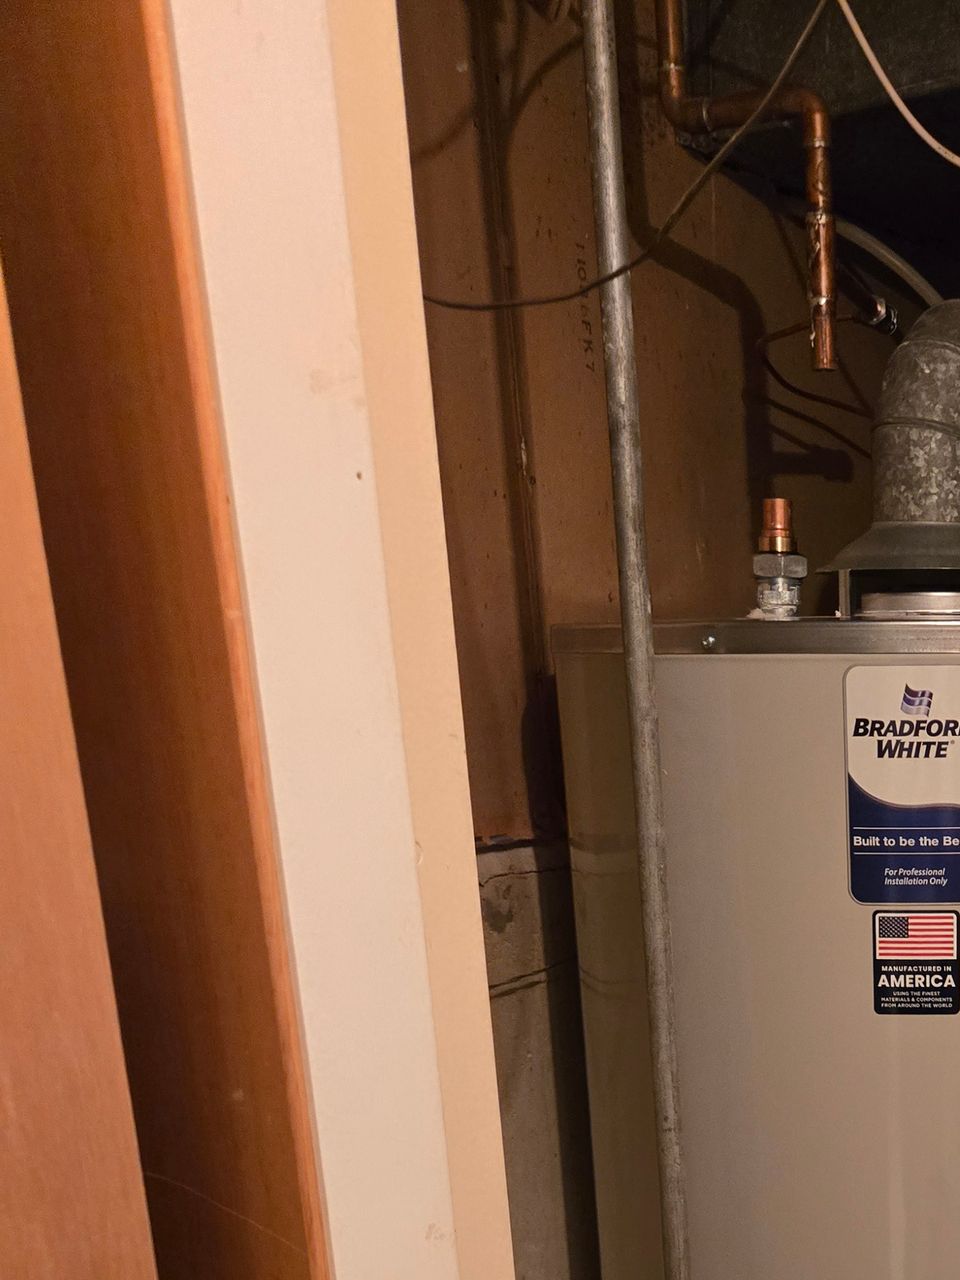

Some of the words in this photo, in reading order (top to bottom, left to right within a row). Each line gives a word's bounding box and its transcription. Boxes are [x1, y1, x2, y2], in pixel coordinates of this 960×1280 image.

[877, 739, 949, 758] WHITE
[853, 836, 880, 846] Built
[883, 836, 896, 846] to
[899, 836, 915, 846] be
[919, 836, 939, 846] the
[884, 868, 897, 876] For
[898, 868, 945, 876] Professional
[884, 877, 928, 885] Installation
[929, 877, 948, 886] Only
[877, 974, 956, 988] AMERICA
